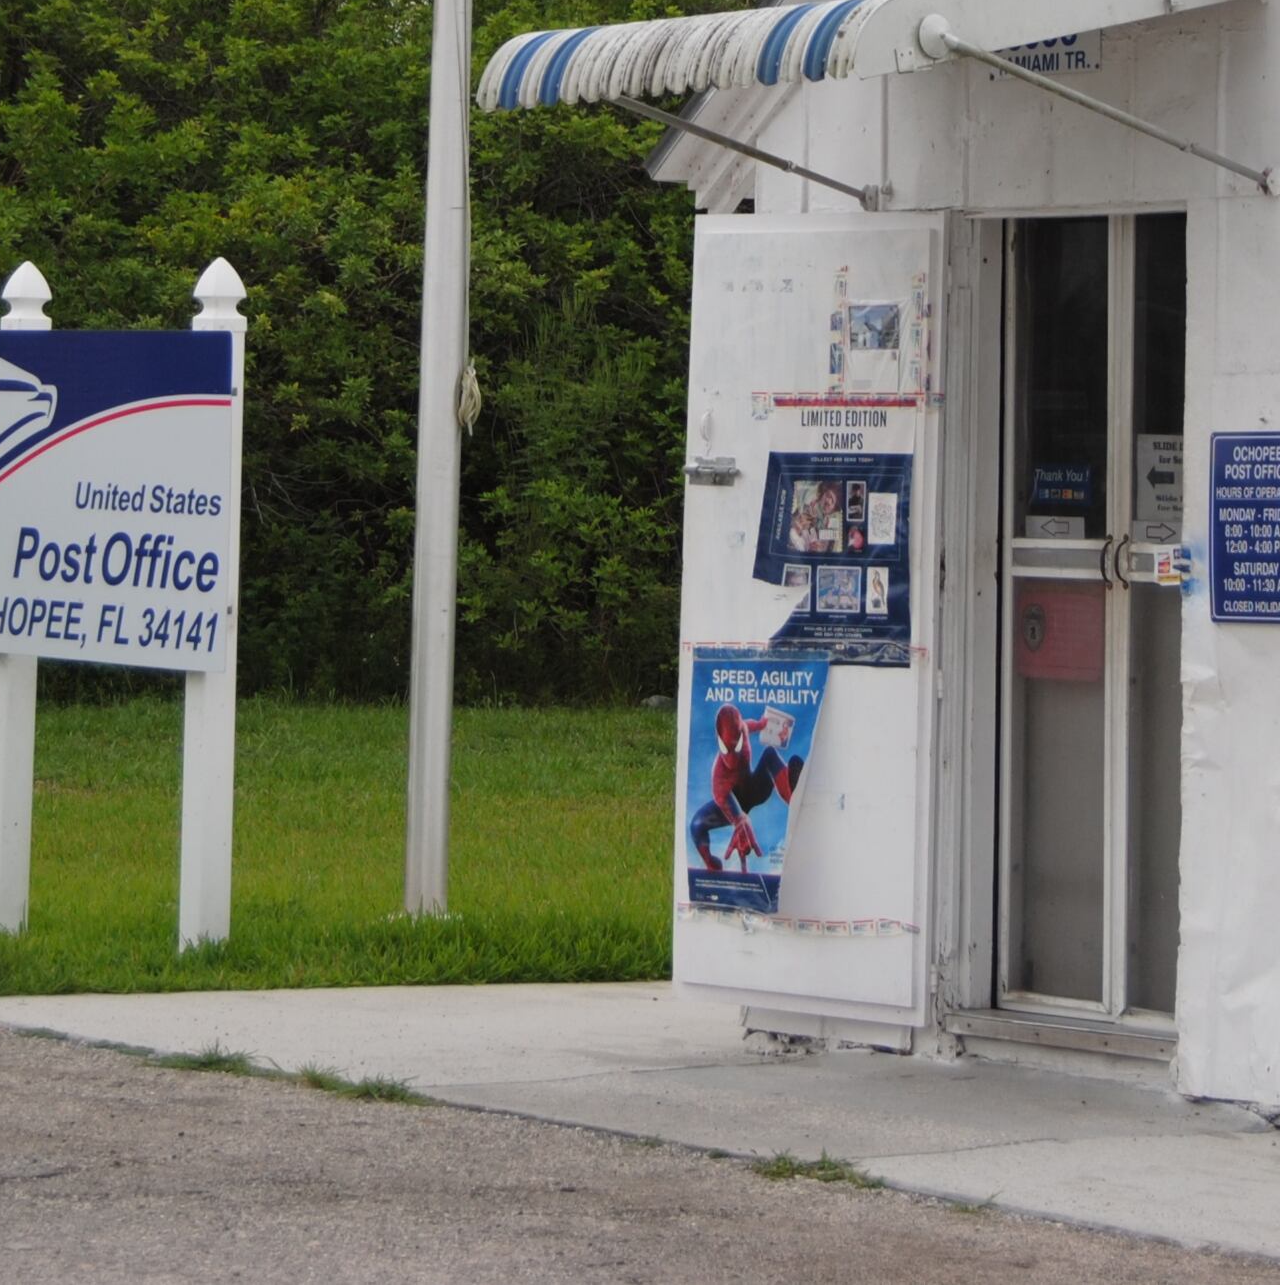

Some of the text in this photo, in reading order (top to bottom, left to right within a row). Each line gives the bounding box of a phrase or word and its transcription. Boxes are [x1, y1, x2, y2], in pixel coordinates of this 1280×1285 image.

[1065, 51, 1090, 69] TR.
[801, 410, 887, 427] LIMITED EDITION
[822, 433, 863, 450] STAMPS
[1035, 468, 1063, 482] Thank
[1066, 469, 1083, 482] You
[1225, 464, 1251, 479] POST
[75, 481, 221, 516] United States
[1216, 487, 1242, 498] HOURS
[1243, 487, 1254, 498] OF
[1219, 508, 1255, 522] MONDAY
[1225, 524, 1242, 537] 8:00
[1250, 525, 1272, 537] 10:00
[1226, 540, 1247, 553] 12:00
[1254, 540, 1273, 554] 4:00
[13, 527, 219, 593] Post Office
[1233, 562, 1279, 576] SATURDAY
[1224, 578, 1245, 591] 10:00
[1253, 578, 1275, 592] 11:30
[1223, 601, 1253, 612] CLOSED
[97, 604, 129, 645] FL
[139, 608, 218, 652] 34141
[712, 670, 813, 688] SPEED, AGILITY
[705, 688, 819, 704] AND RELIABILITY
